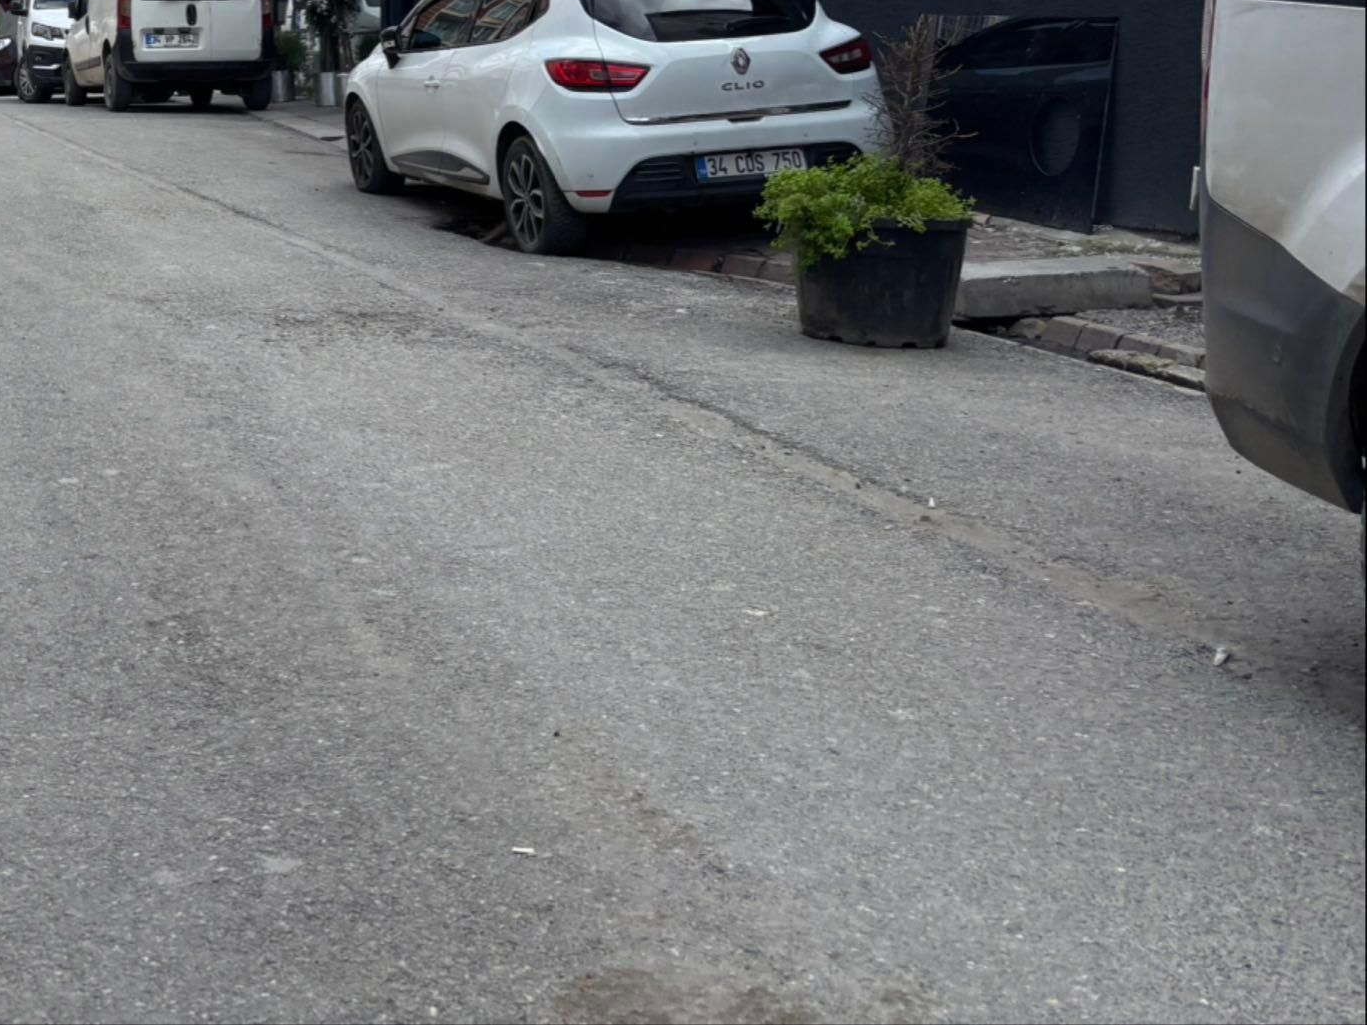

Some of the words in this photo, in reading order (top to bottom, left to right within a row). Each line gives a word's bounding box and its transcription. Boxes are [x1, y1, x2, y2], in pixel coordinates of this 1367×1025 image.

[721, 80, 765, 91] CLIO
[707, 157, 728, 176] 34
[771, 151, 802, 171] 750
